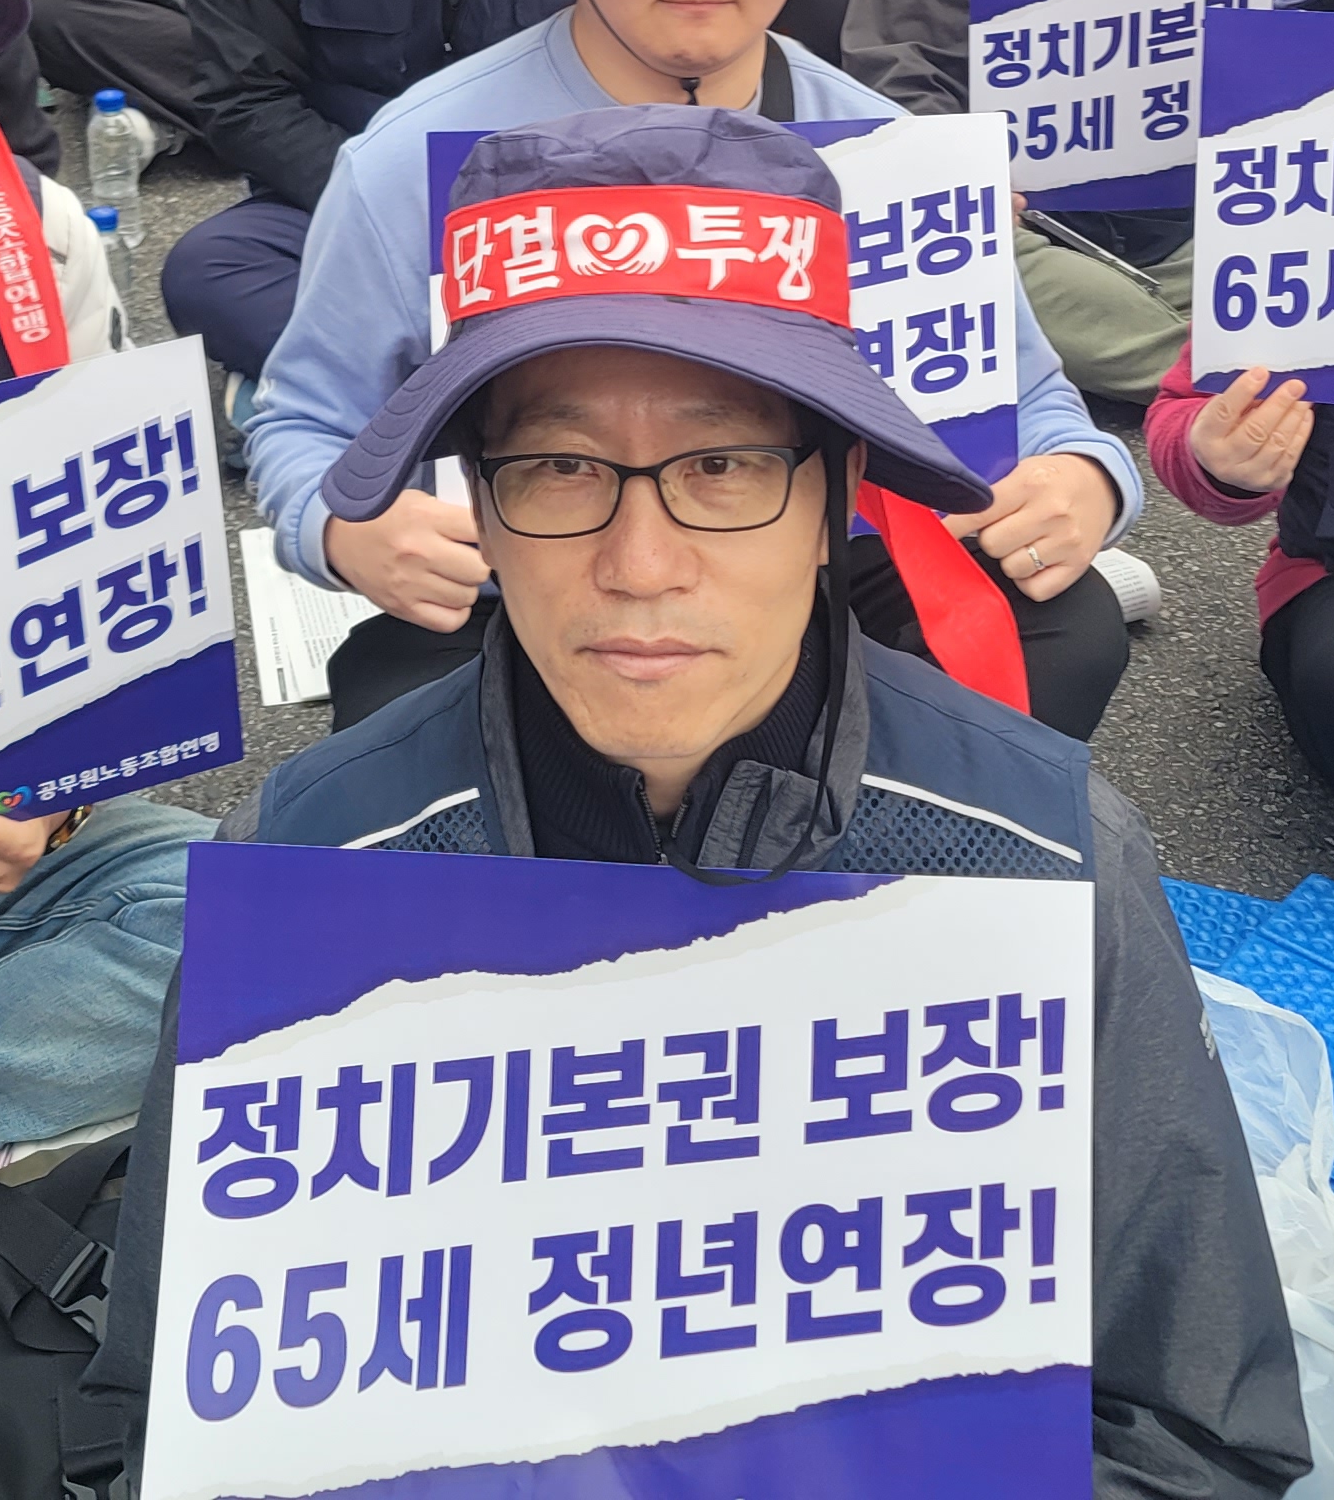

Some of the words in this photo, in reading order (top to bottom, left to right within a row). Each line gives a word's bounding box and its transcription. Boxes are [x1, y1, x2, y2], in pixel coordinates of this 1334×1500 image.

[450, 205, 563, 310] 단결
[674, 203, 821, 303] 투쟁
[843, 184, 999, 291] 보장!
[11, 408, 201, 570] 보장!
[35, 730, 221, 801] 공무원노동조합연맹
[196, 1024, 763, 1221] 정치기본권
[803, 991, 1069, 1148] 보장!
[185, 1243, 473, 1423] 65세
[527, 1181, 1062, 1375] 정년연장!
